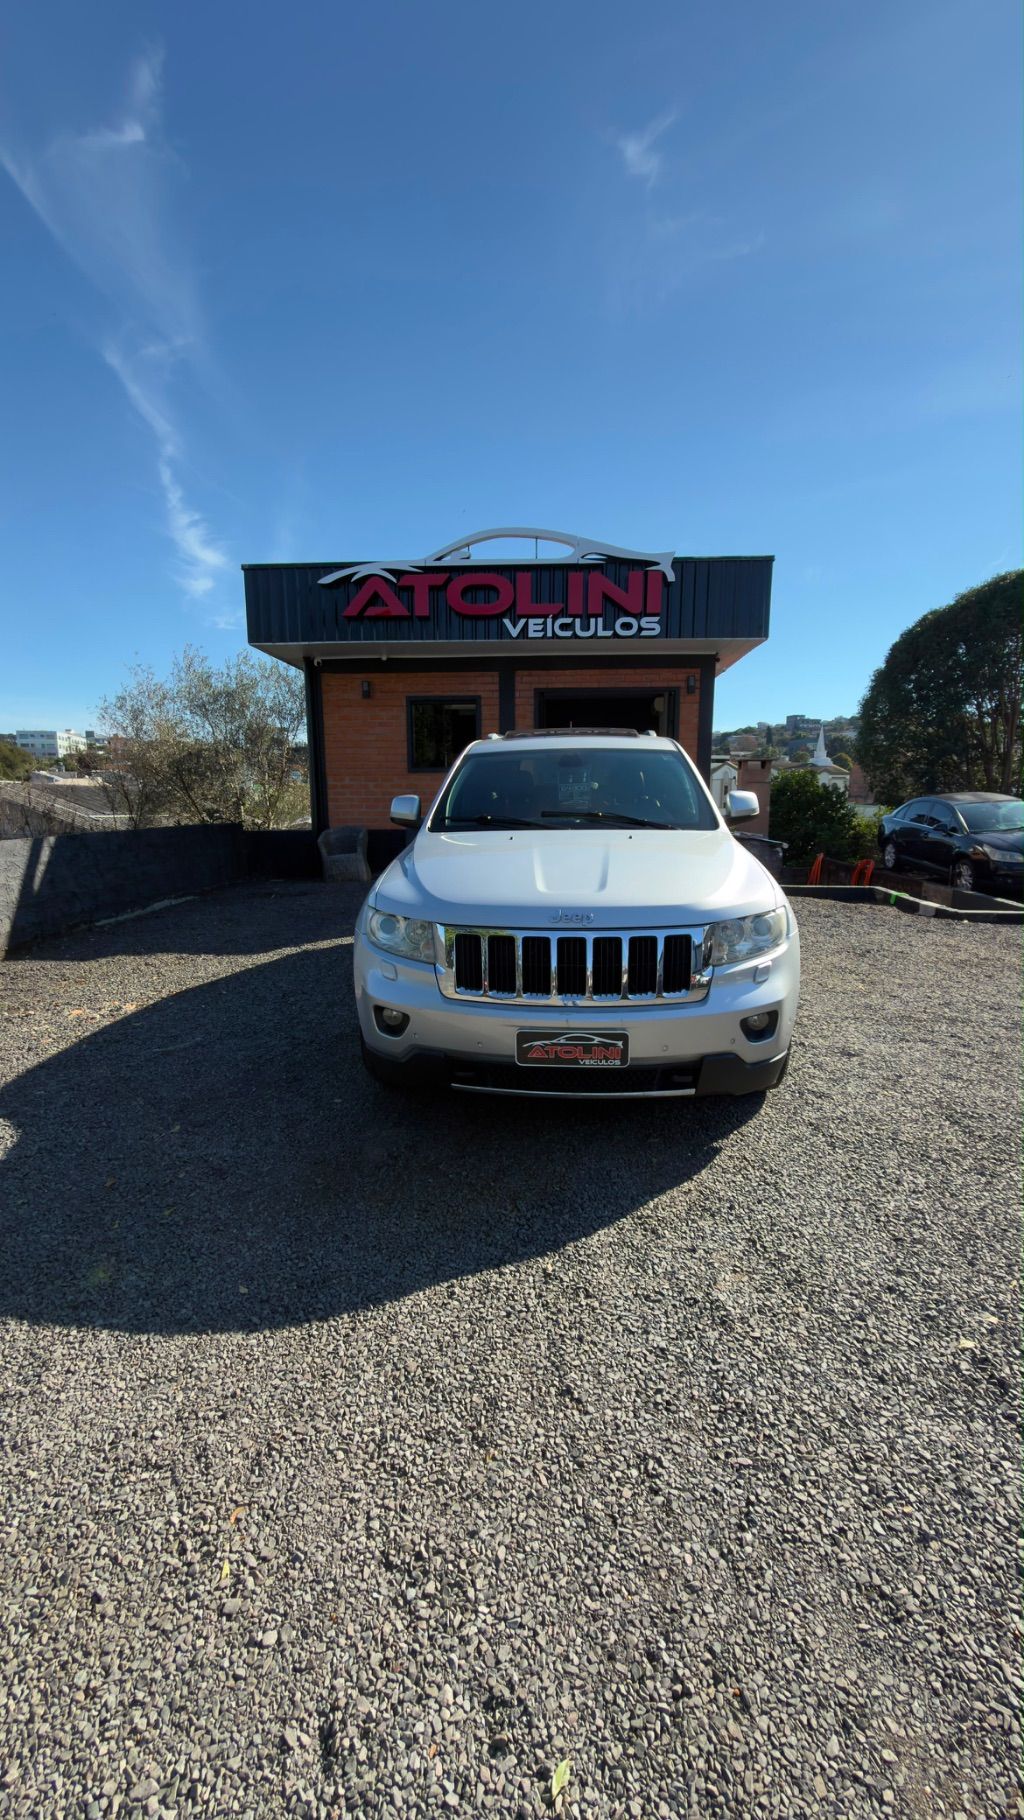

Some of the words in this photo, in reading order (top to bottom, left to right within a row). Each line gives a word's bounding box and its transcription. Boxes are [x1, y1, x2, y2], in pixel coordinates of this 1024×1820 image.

[343, 571, 662, 617] ATOLINI
[503, 615, 661, 638] VEÍCULOS
[550, 908, 594, 926] Jeep
[527, 1046, 621, 1059] ATOLINI
